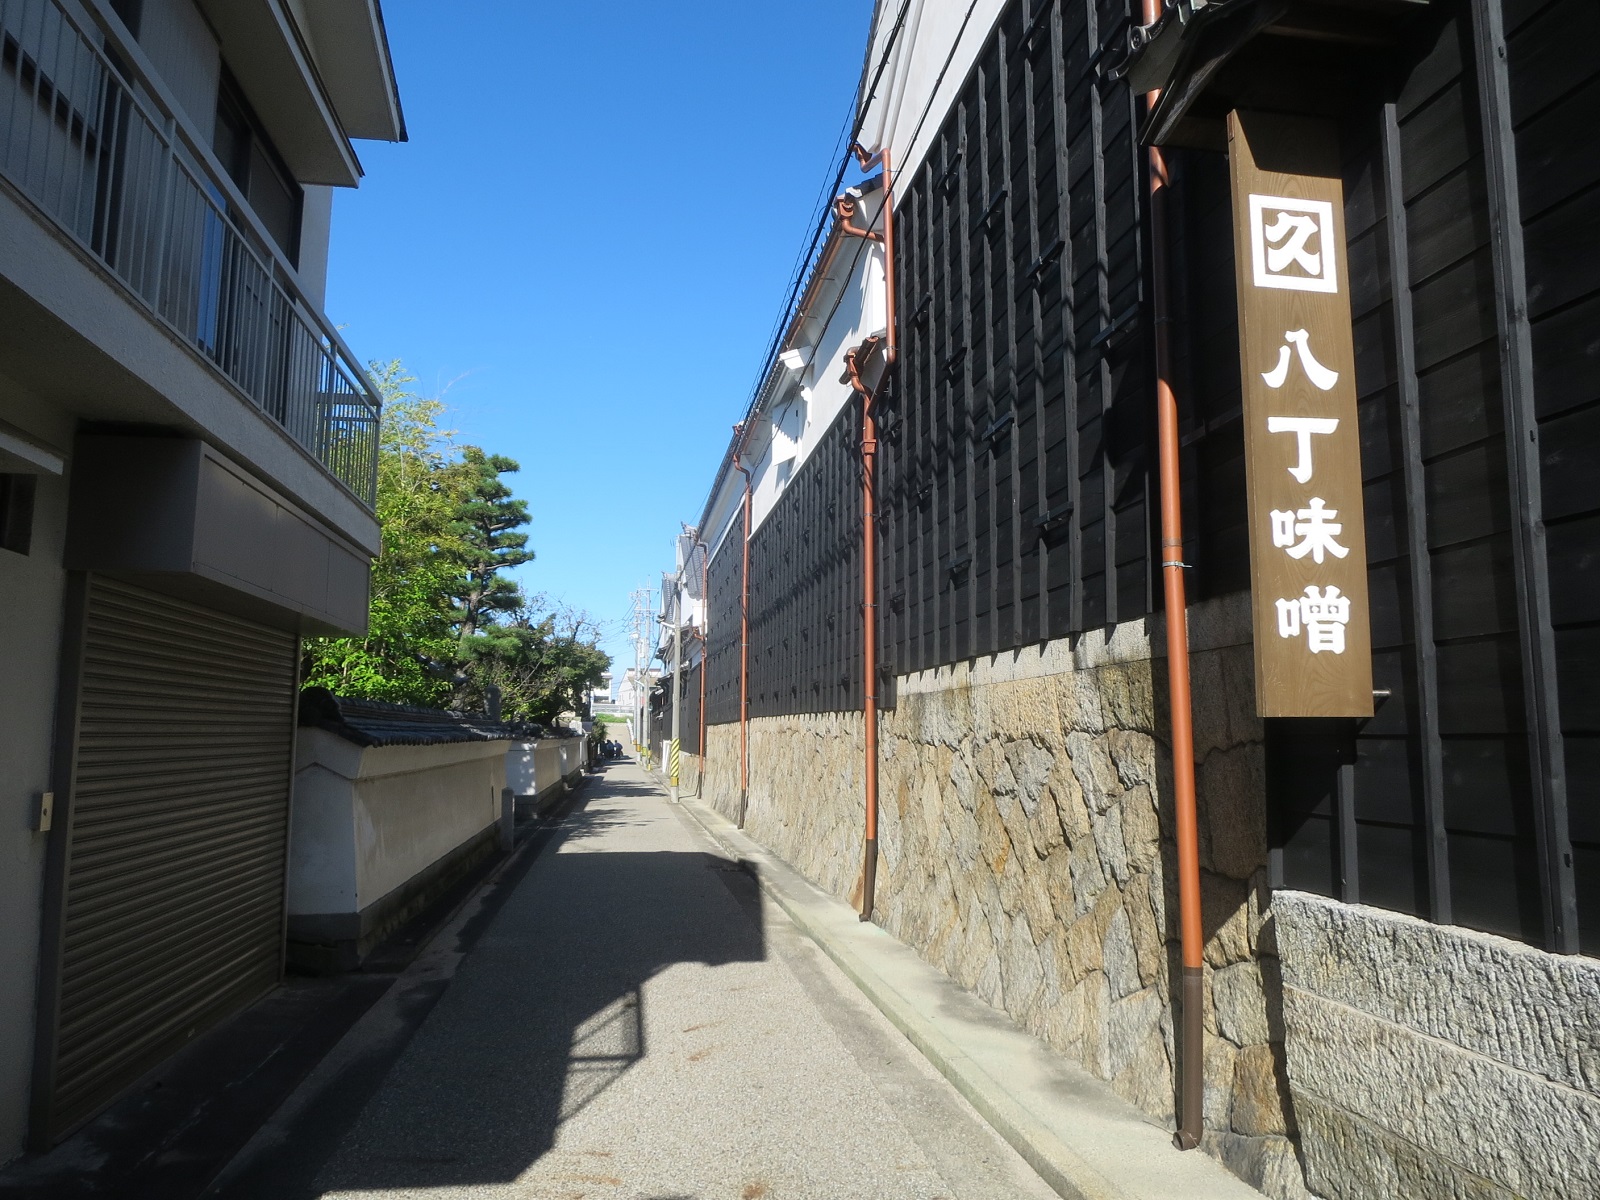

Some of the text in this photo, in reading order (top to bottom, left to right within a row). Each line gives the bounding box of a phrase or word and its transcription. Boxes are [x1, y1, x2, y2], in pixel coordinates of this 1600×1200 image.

[1265, 212, 1321, 275] 久
[1261, 329, 1350, 654] 八丁味噌
